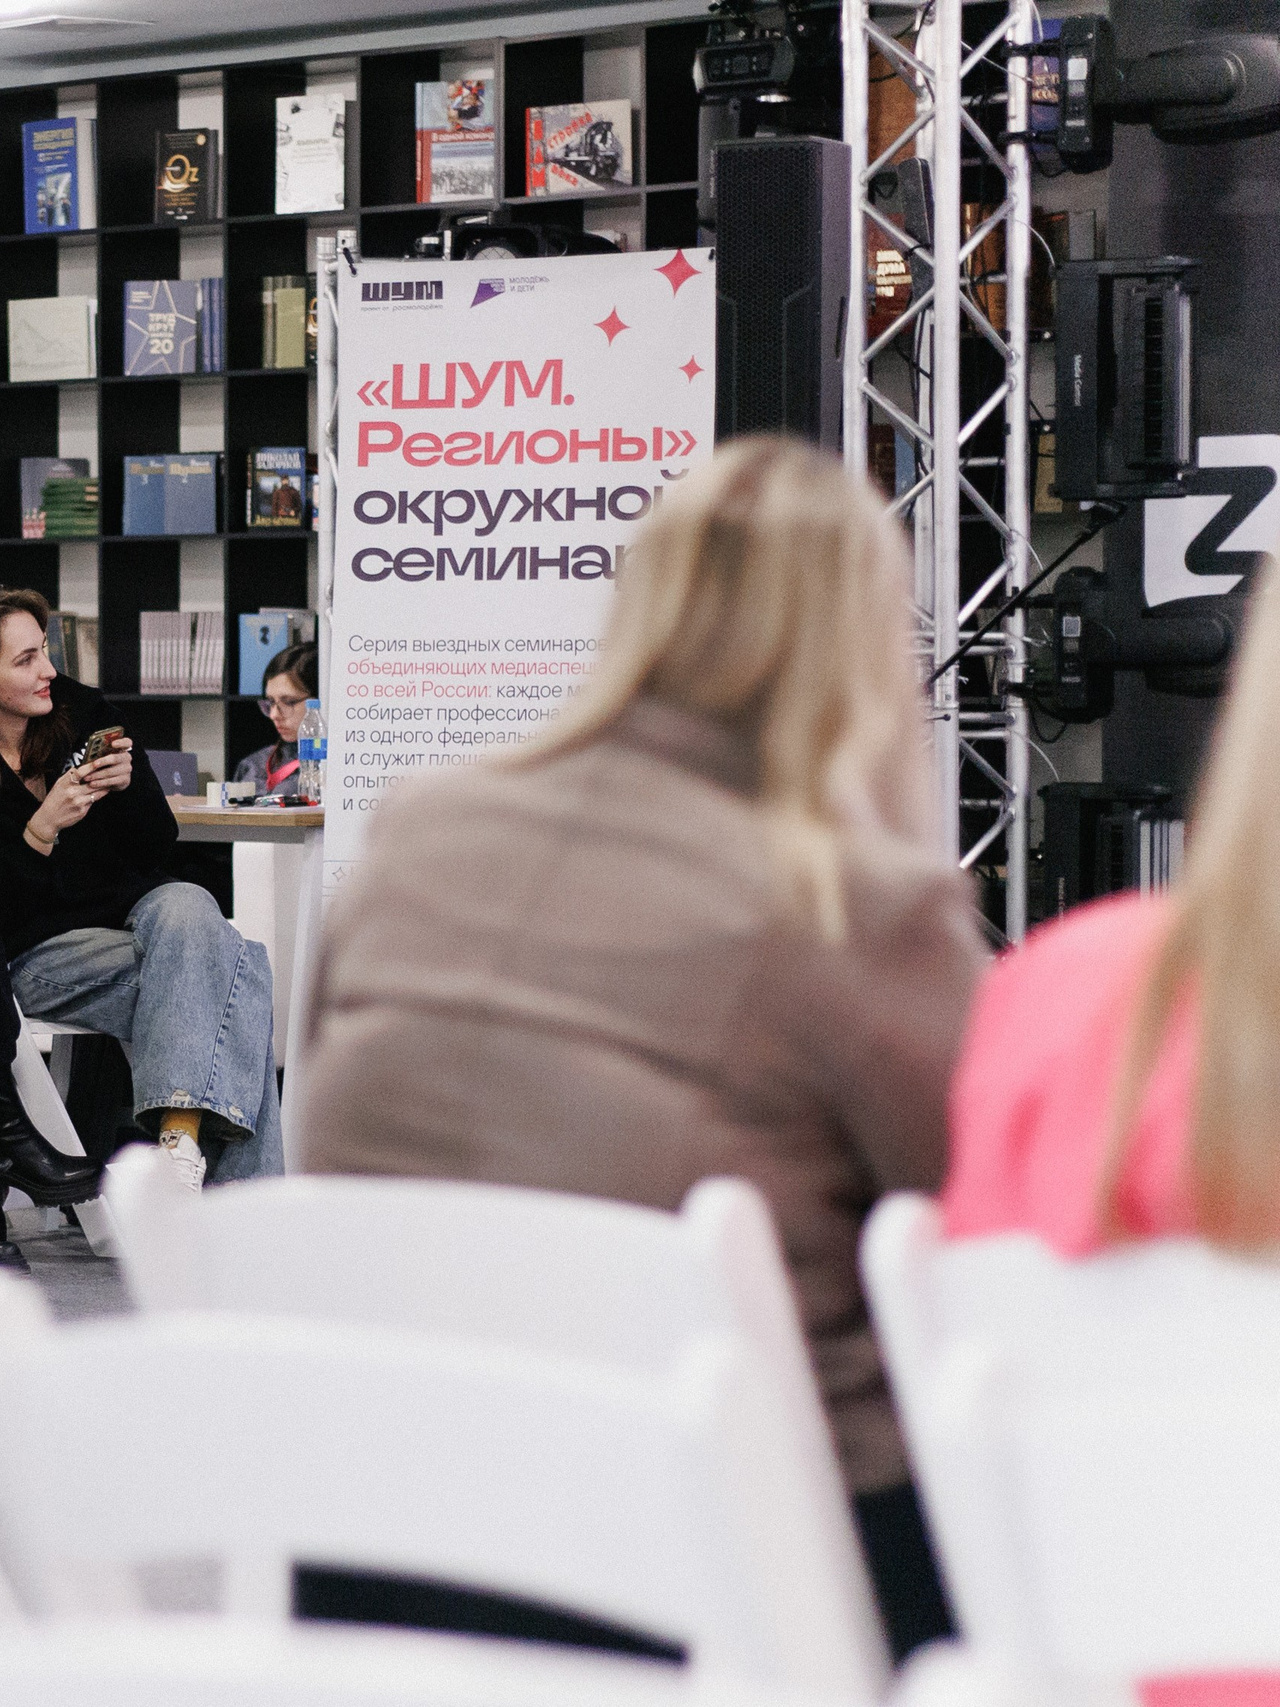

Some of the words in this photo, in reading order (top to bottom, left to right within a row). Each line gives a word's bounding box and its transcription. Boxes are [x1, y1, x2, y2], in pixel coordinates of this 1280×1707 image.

[361, 280, 443, 301] ШУМ
[150, 338, 175, 355] 20
[356, 358, 575, 410] «ШУМ.
[357, 421, 698, 468] Регионы»
[348, 635, 408, 655] Серия
[412, 637, 500, 654] выездных
[347, 659, 486, 676] объединяющих
[491, 661, 597, 677] медиаспец
[346, 684, 369, 698] со
[373, 681, 416, 698] всей
[421, 681, 492, 698] России:
[496, 684, 563, 701] каждое
[346, 703, 433, 723] собирает
[436, 704, 561, 725] профессиона
[345, 729, 366, 743] из
[370, 729, 433, 745] одного
[437, 727, 540, 748] федеральн
[344, 753, 356, 765] и
[360, 753, 425, 770] служит
[343, 775, 410, 789] опыто
[342, 798, 354, 811] и
